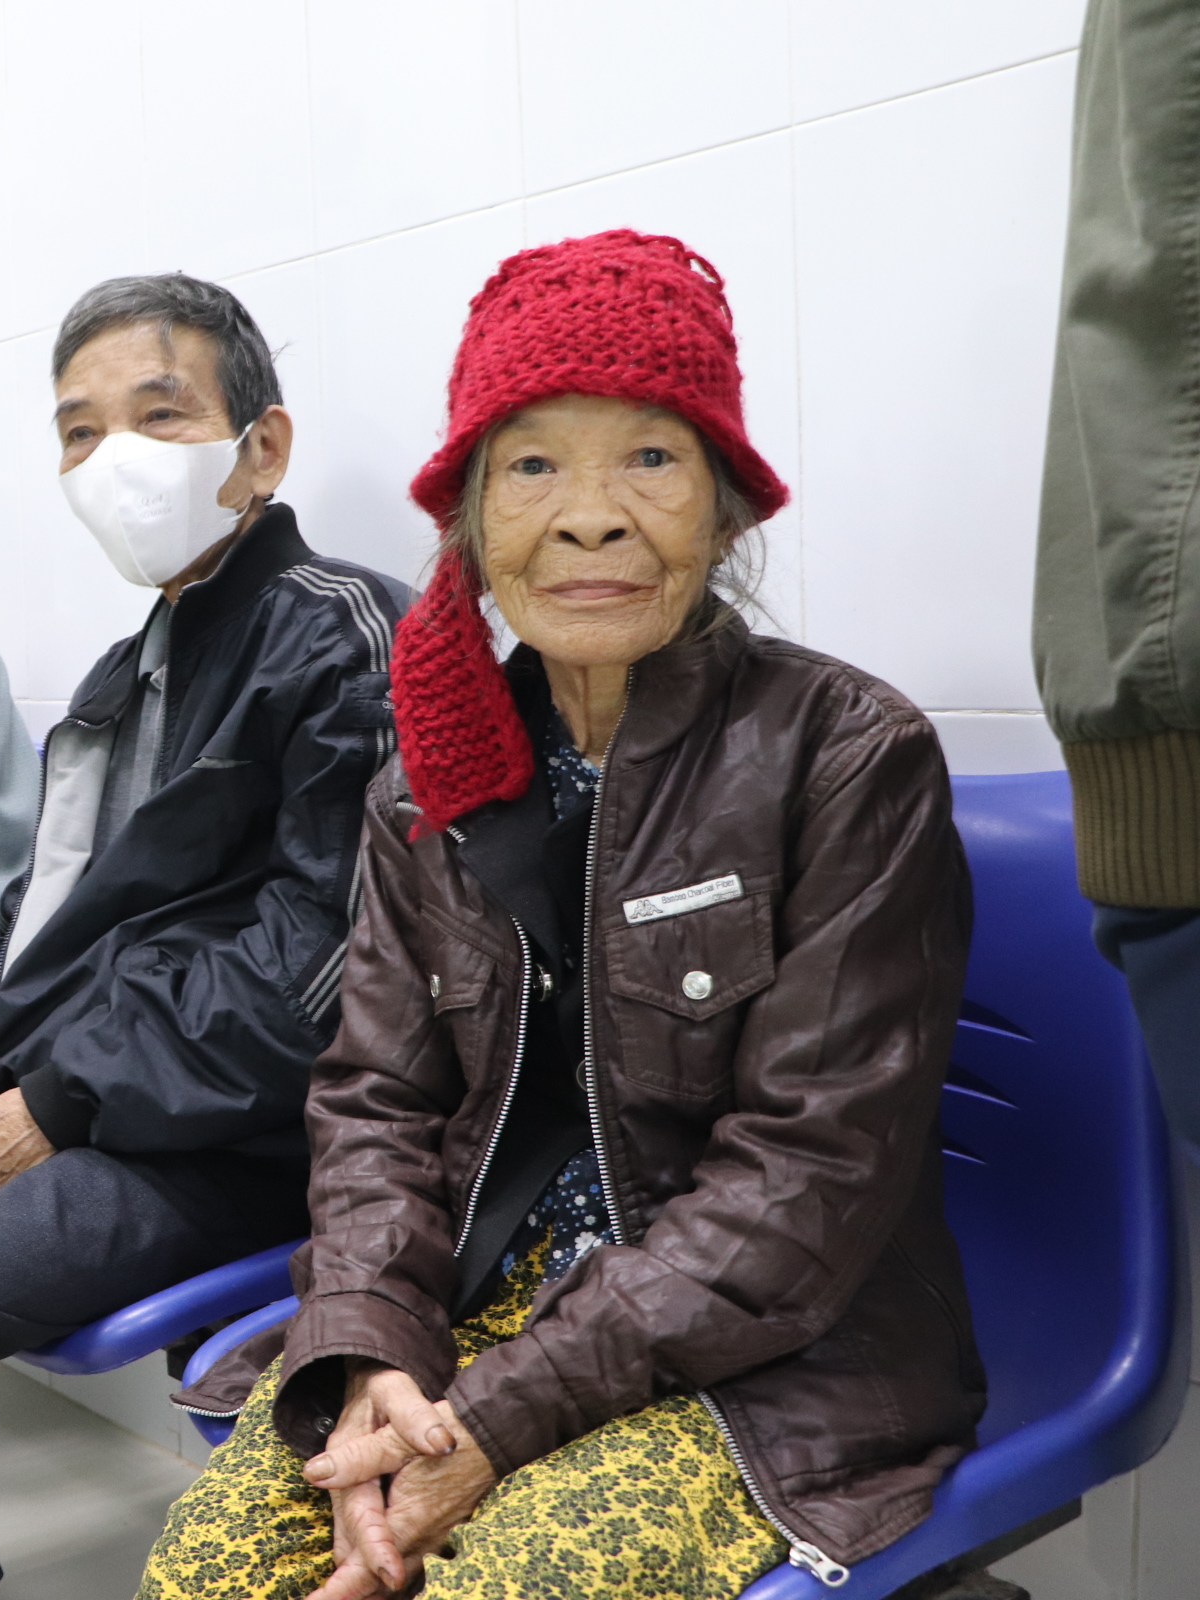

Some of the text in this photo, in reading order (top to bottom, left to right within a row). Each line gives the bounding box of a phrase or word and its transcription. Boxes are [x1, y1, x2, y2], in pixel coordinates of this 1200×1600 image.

[661, 892, 687, 905] Bamboo
[687, 884, 715, 899] Charcoal
[716, 879, 735, 889] Fiber
